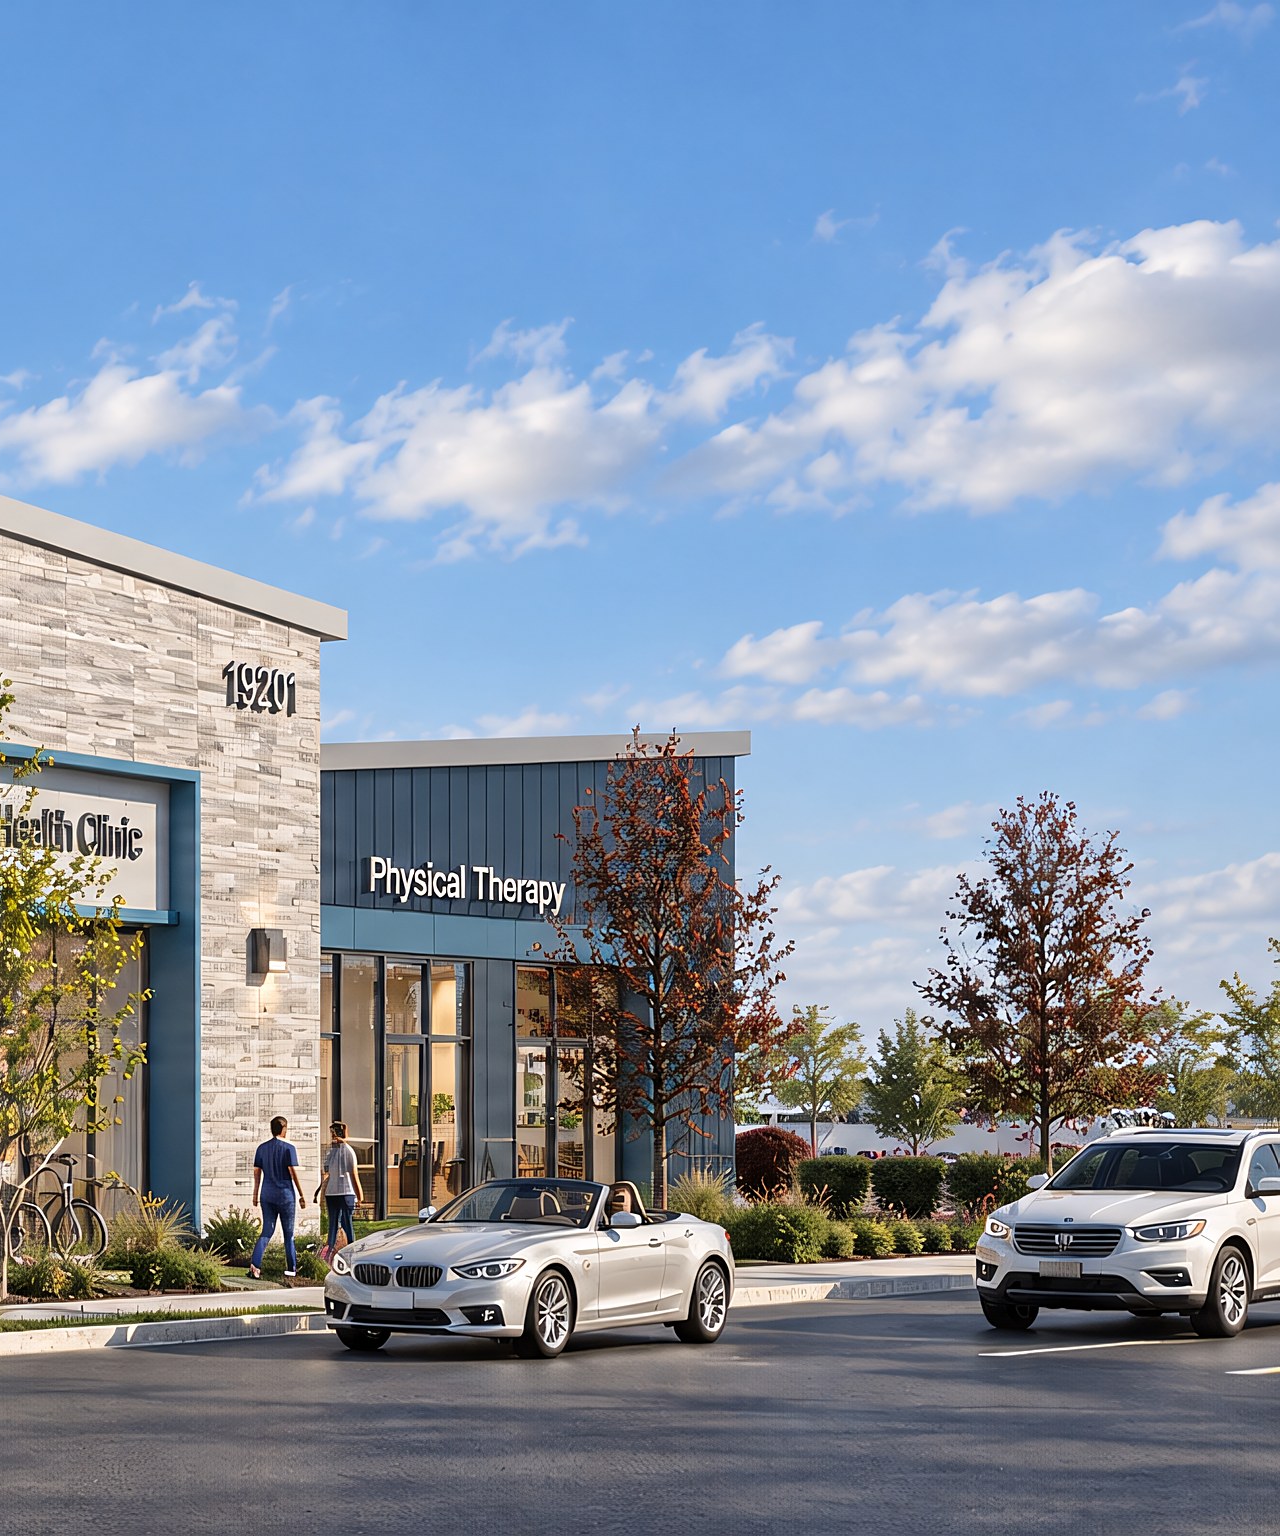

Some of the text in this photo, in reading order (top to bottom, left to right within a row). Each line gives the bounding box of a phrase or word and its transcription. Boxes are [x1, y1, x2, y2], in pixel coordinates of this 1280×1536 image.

[222, 660, 297, 717] 19201
[77, 812, 144, 861] Clinic
[368, 856, 567, 916] Physical Therapy
